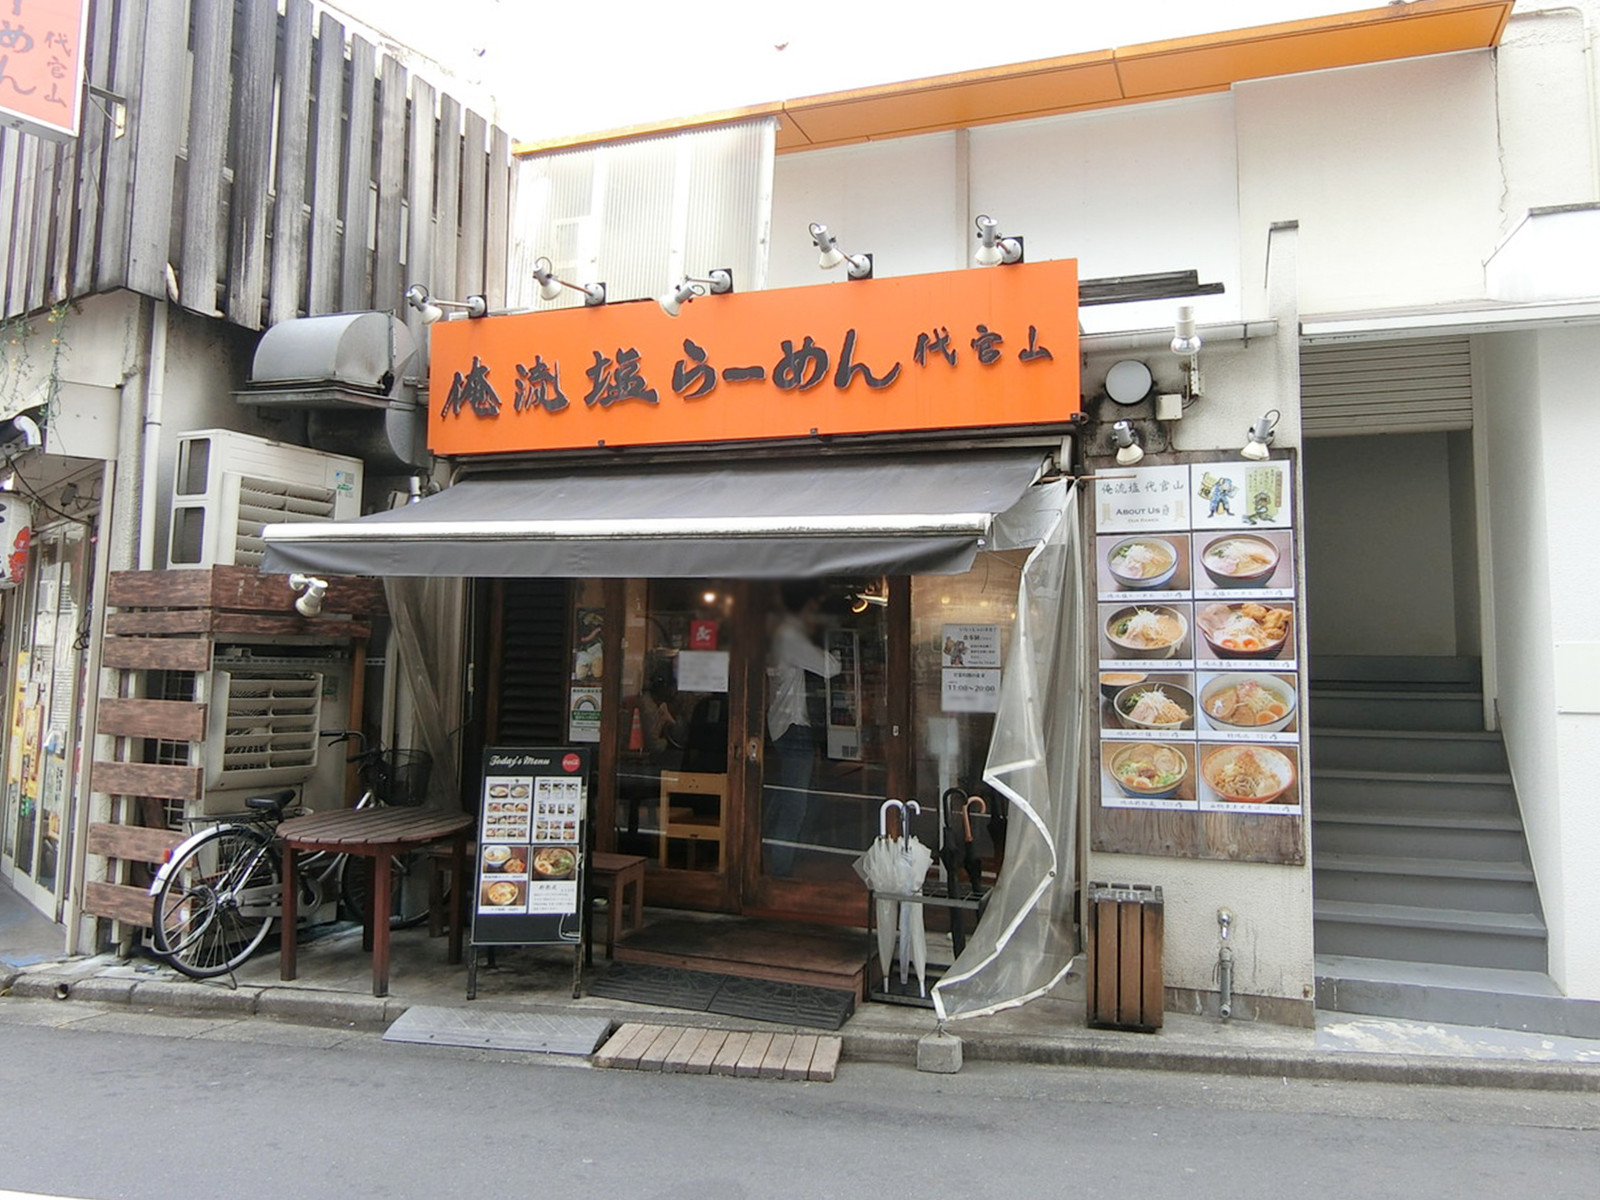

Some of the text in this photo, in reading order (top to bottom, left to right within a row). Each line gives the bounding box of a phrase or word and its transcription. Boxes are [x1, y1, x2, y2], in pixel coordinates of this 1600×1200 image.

[44, 31, 72, 108] 代官山
[913, 324, 1053, 368] 代官山
